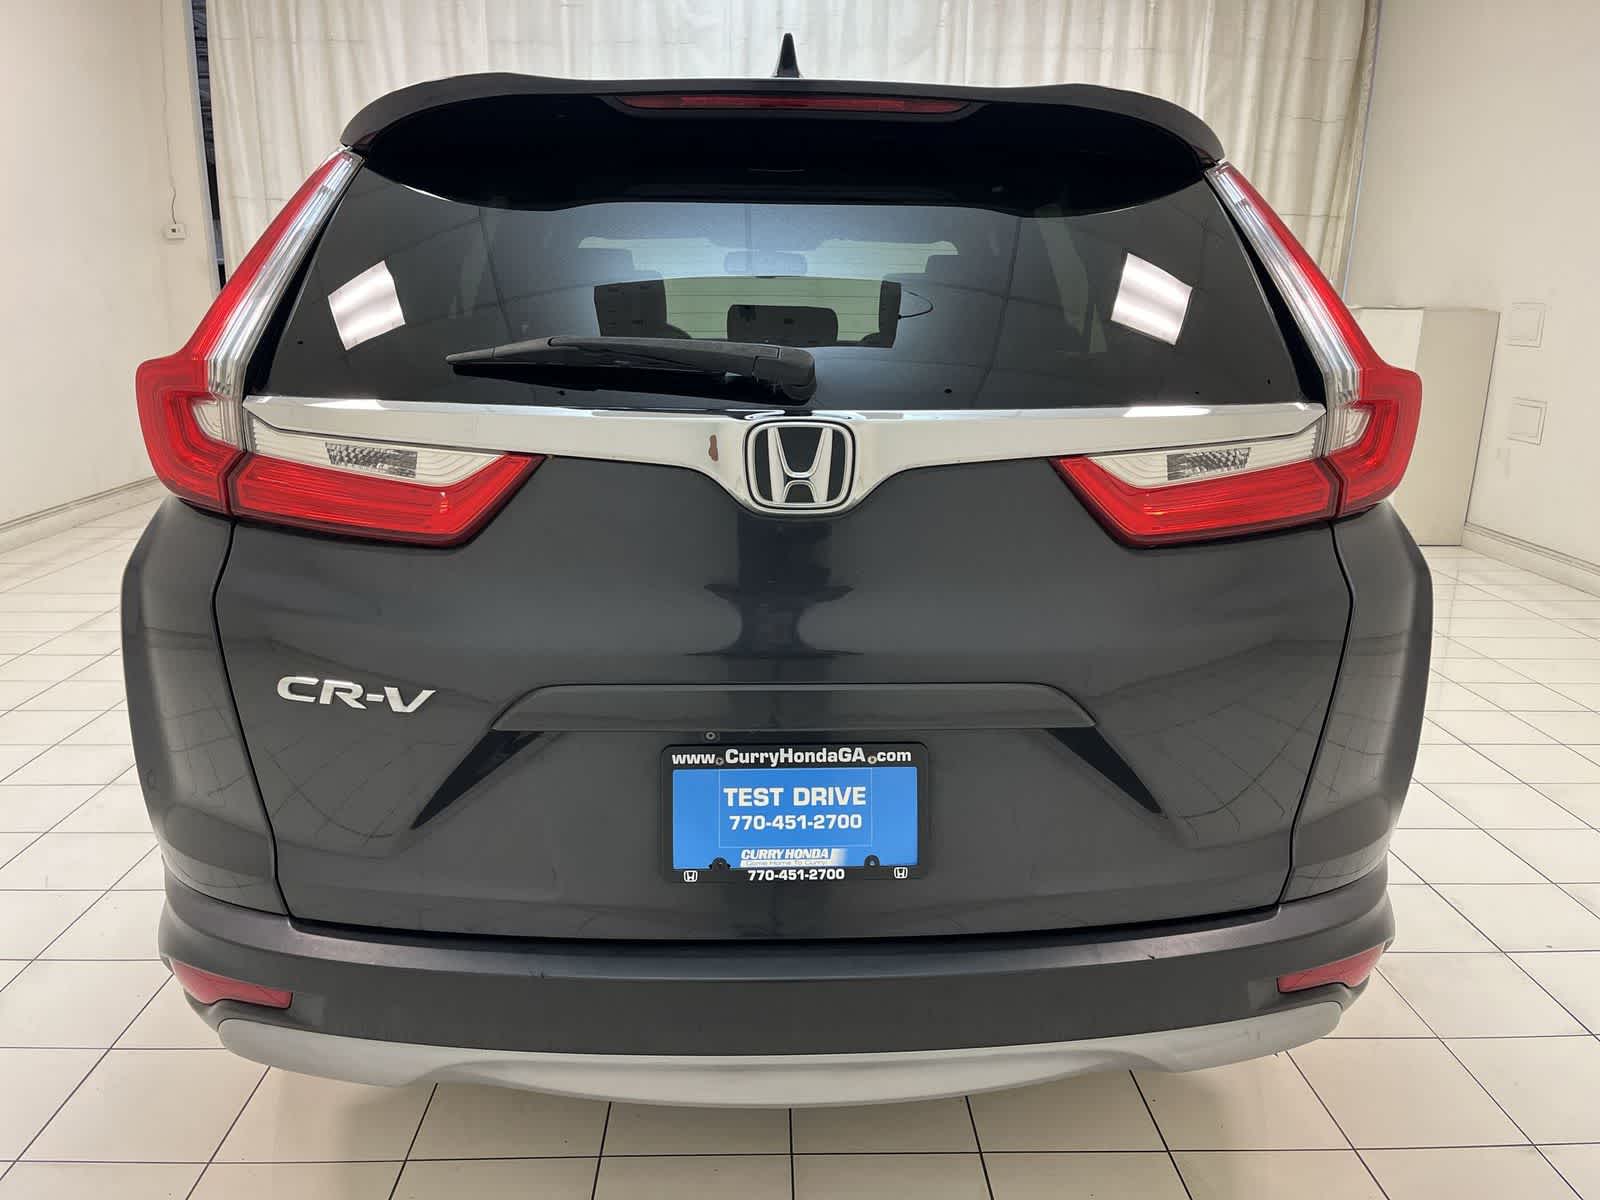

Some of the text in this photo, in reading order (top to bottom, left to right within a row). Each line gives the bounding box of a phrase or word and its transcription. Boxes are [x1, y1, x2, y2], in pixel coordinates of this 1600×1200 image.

[277, 676, 437, 713] CR-V
[723, 786, 867, 807] TEST DRIVE
[729, 814, 862, 830] 770-451-2700
[741, 848, 829, 860] CURRY HONDA
[747, 868, 845, 881] 770-451-2700
